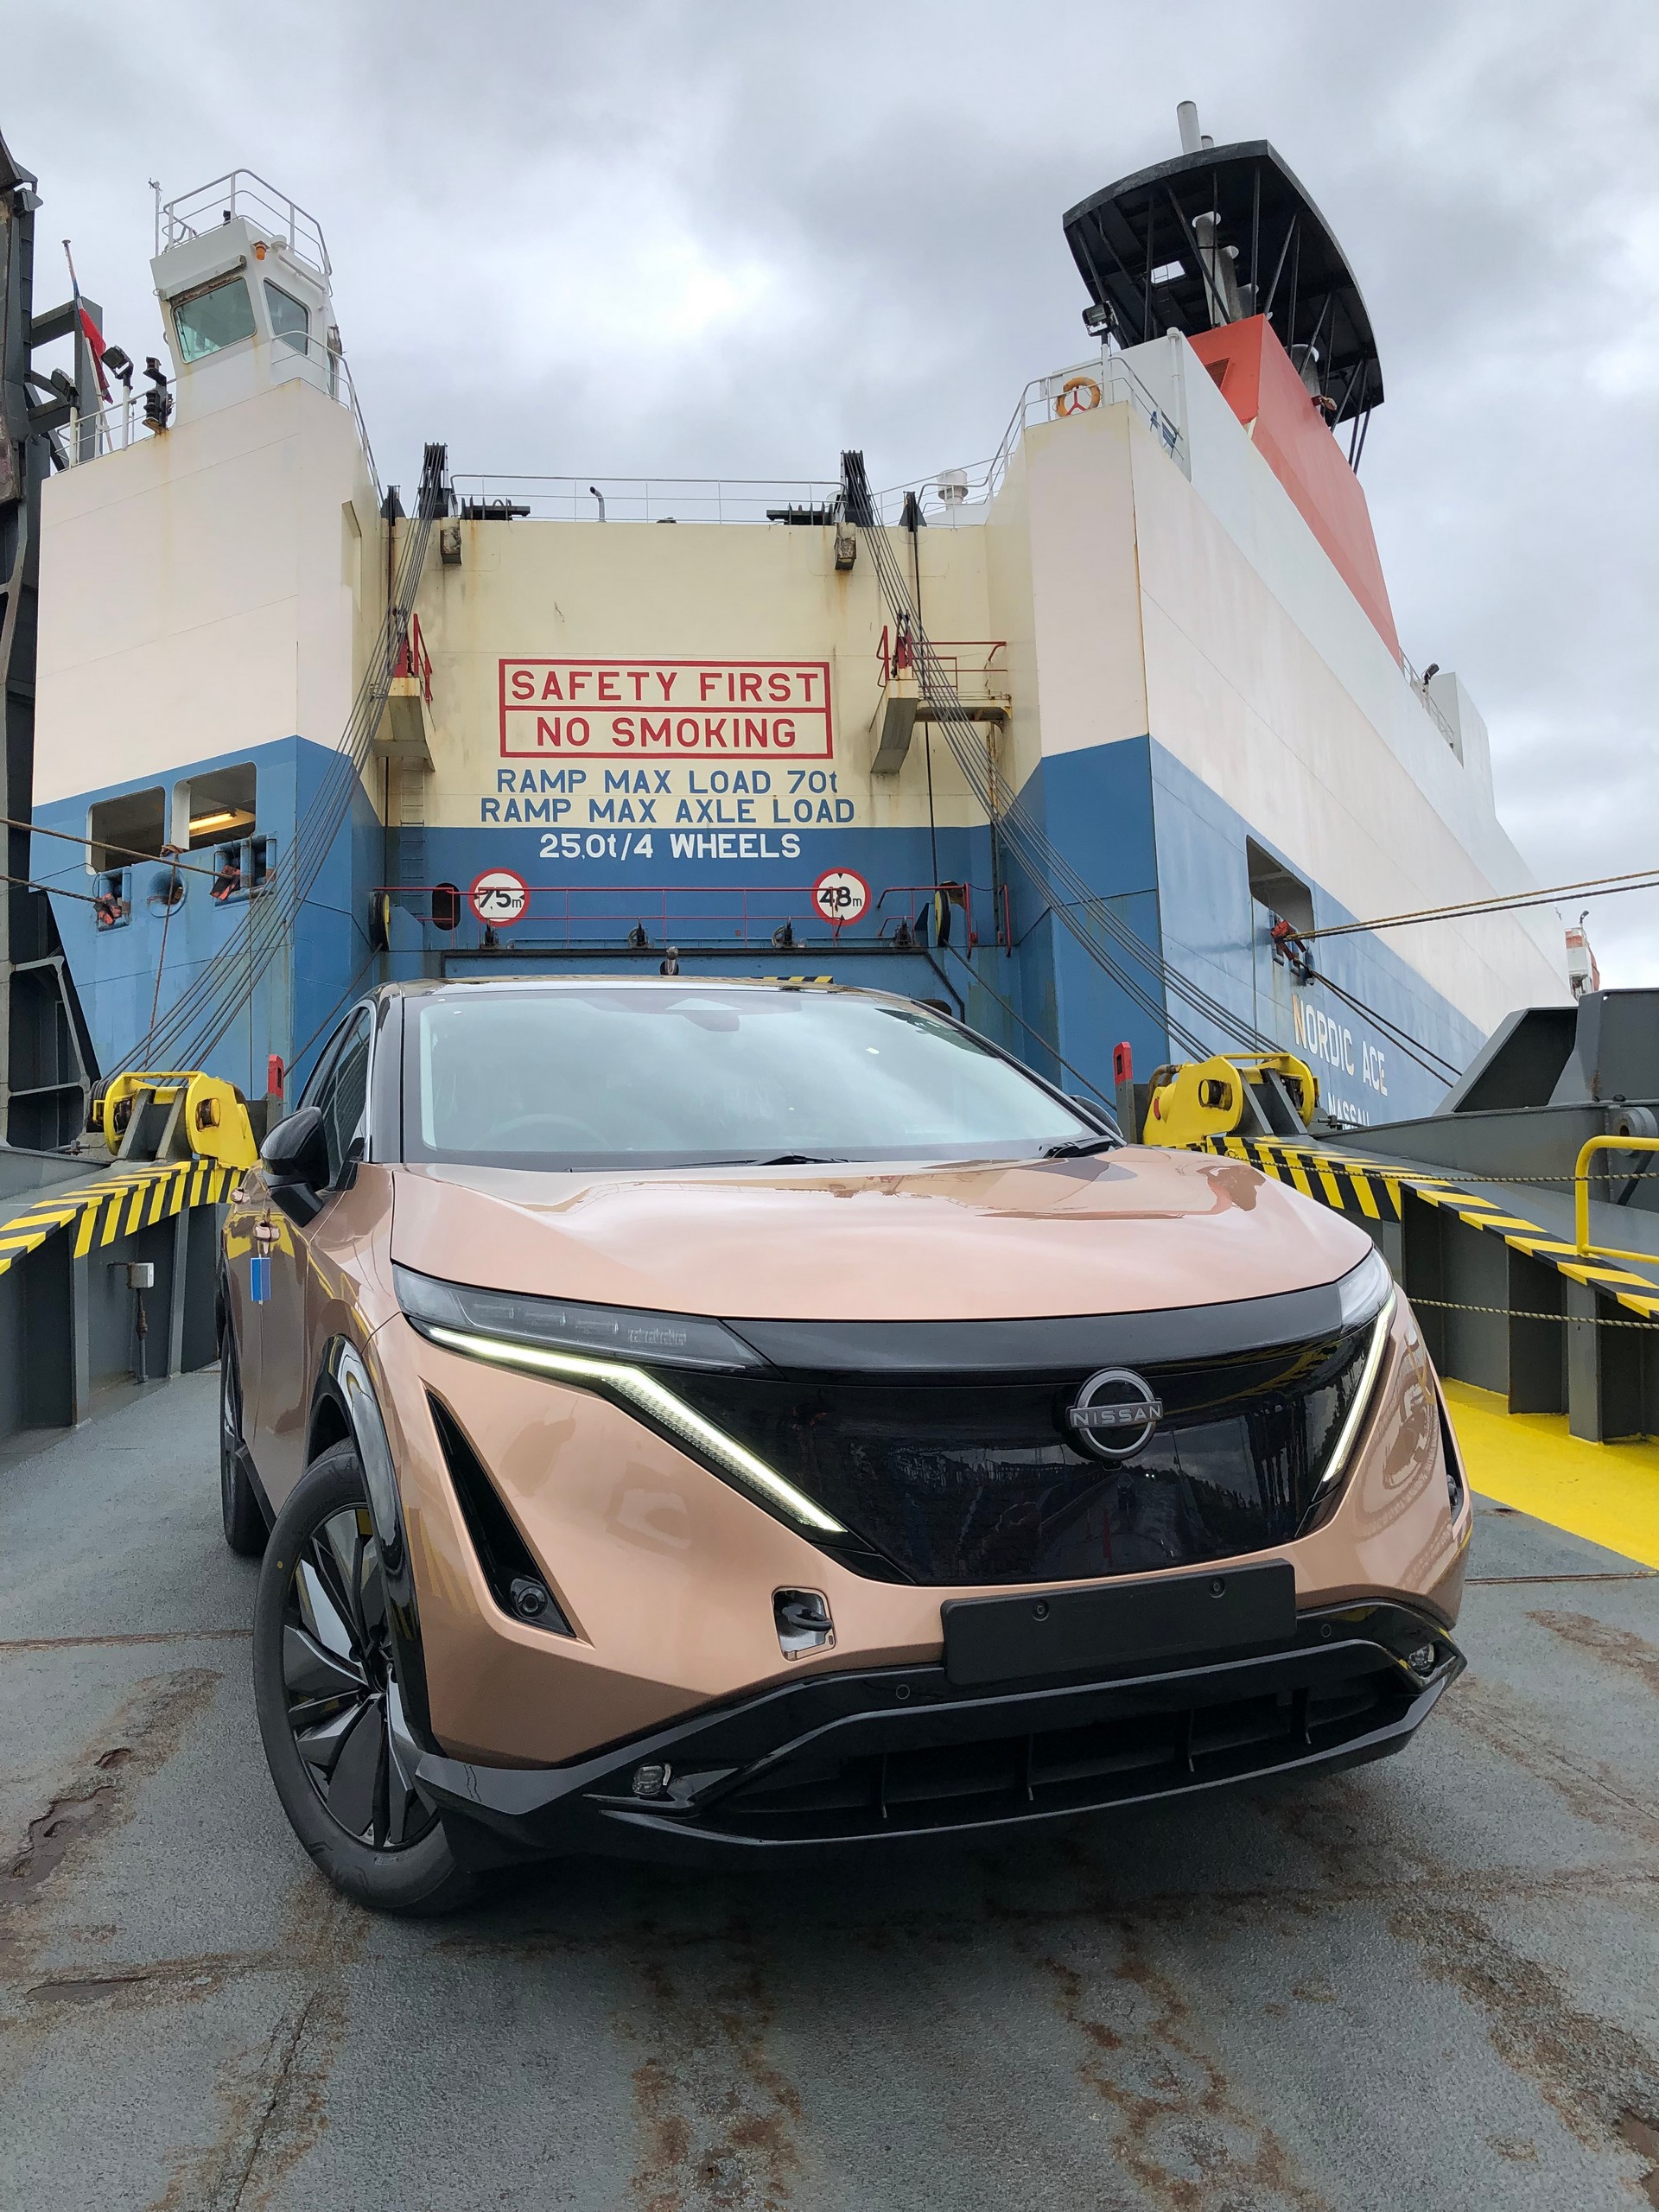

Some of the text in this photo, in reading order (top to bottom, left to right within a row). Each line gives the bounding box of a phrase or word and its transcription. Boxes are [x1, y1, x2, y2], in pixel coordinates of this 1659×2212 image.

[512, 671, 818, 702] SAFETY FIRST
[537, 716, 796, 748] NO SMOKING
[497, 768, 838, 794] RAMP MAX LOAD 70t
[480, 798, 855, 823] RAMP MAX AXLE LOAD
[670, 833, 801, 859] WHEELS
[1291, 994, 1388, 1096] NORDIC ACE
[1073, 1404, 1161, 1426] NISSAN
